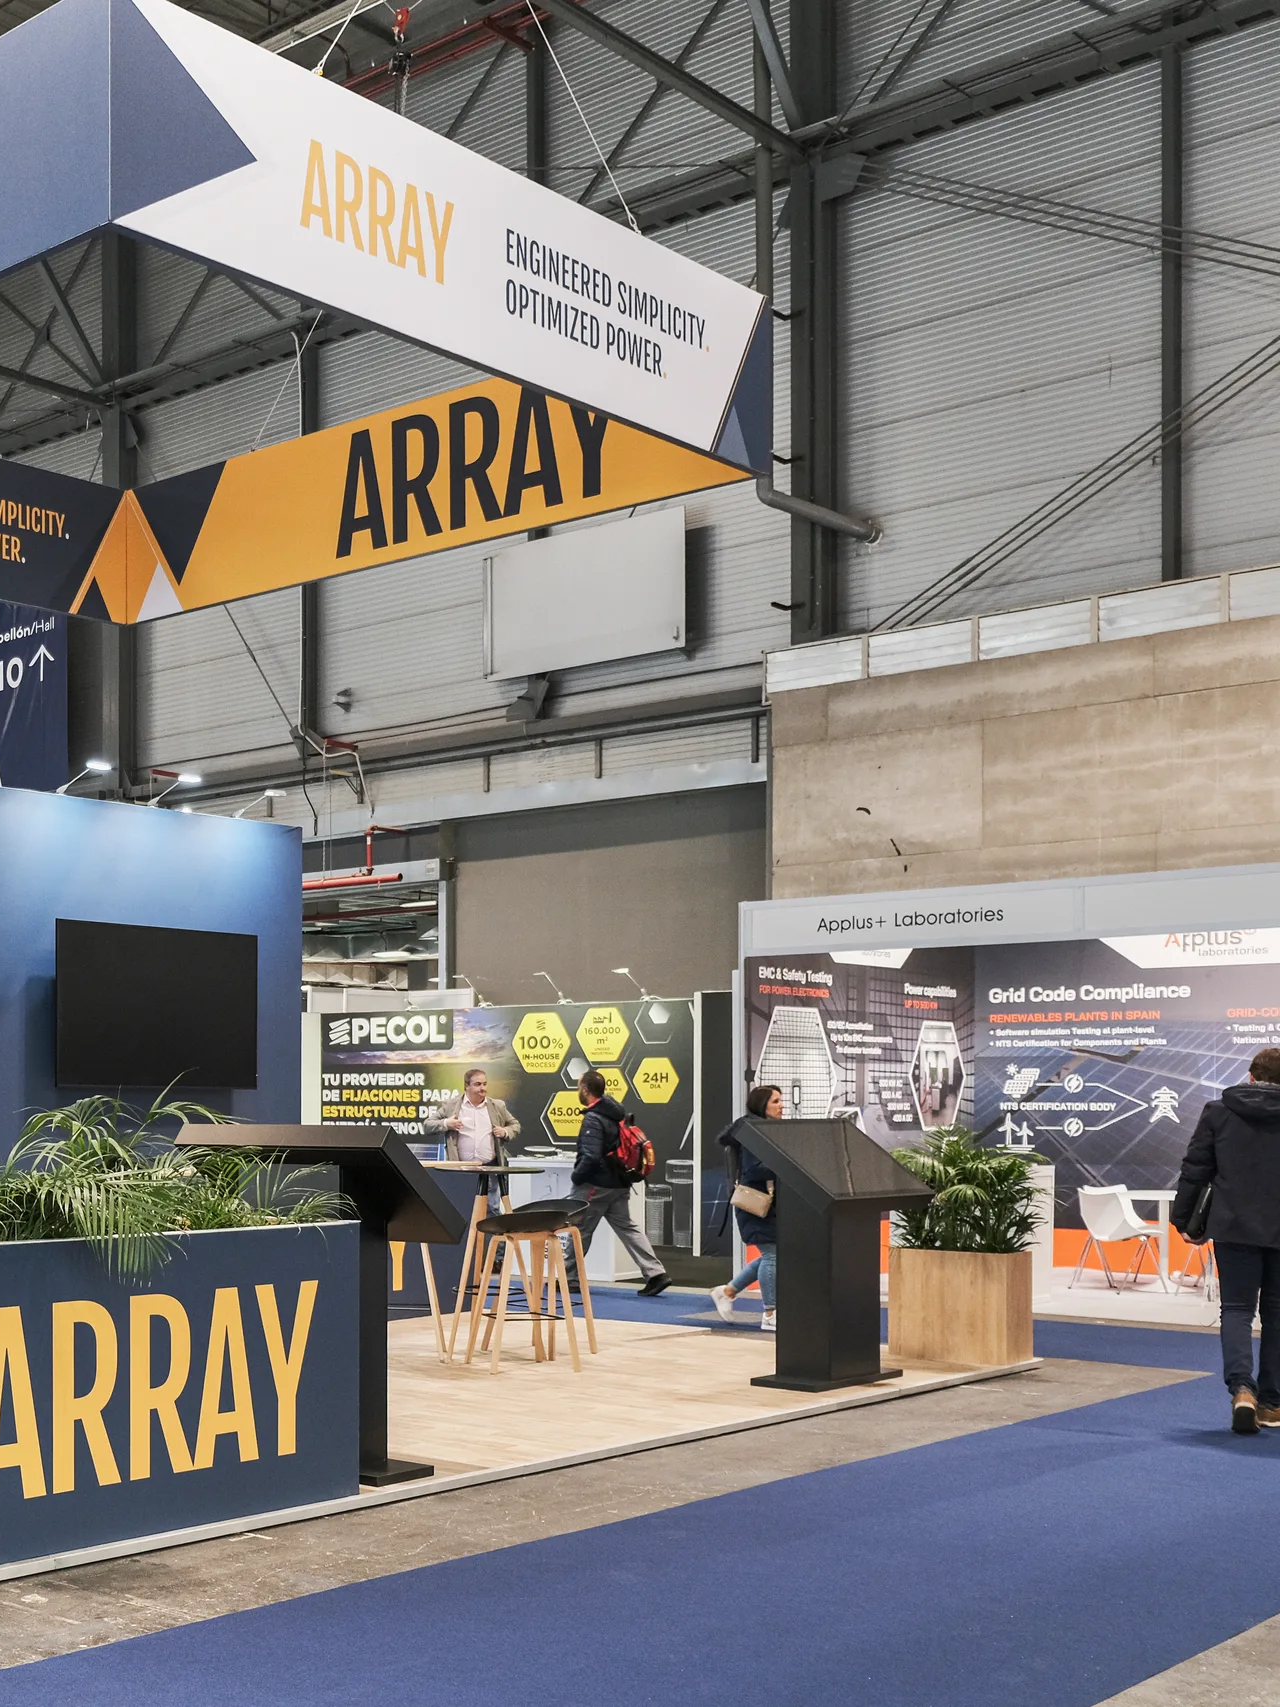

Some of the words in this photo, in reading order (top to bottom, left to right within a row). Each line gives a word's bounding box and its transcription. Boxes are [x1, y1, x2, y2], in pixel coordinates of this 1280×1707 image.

[299, 138, 455, 285] ARRAY
[506, 228, 612, 307] ENGINEERED
[617, 281, 710, 352] SIMPLICITY.
[506, 279, 600, 350] OPTIMIZED
[606, 322, 667, 379] POWER.
[335, 386, 609, 559] ARRAY
[817, 915, 887, 935] Applus+
[894, 907, 1004, 927] Laboratories
[1198, 946, 1269, 957] laboratories
[758, 966, 776, 980] EMC
[776, 967, 782, 980] &
[782, 968, 807, 985] Safety
[806, 970, 833, 987] Testing
[759, 984, 771, 994] FOR
[771, 985, 792, 996] POWER
[792, 987, 830, 999] ELECTRONICS
[904, 982, 923, 996] Power
[923, 985, 957, 999] capabilities
[988, 987, 1025, 1004] Grid
[1028, 985, 1076, 1003] Code
[1079, 982, 1191, 1004] Compliance
[989, 1012, 1063, 1024] RENEWABLES
[1064, 1011, 1109, 1022] PLANTS
[1111, 1011, 1123, 1021] IN
[1125, 1010, 1161, 1021] SPAIN
[1226, 1007, 1280, 1018] GRID-CO
[584, 1027, 621, 1035] 160.000
[995, 1027, 1030, 1036] Software
[1030, 1027, 1071, 1036] simulation
[1071, 1026, 1101, 1037] Testing
[1111, 1025, 1155, 1036] plant-level
[1233, 1024, 1266, 1033] Testing
[519, 1035, 564, 1050] 100%
[995, 1039, 1012, 1048] NTS
[1012, 1038, 1060, 1048] Certification
[1060, 1038, 1072, 1047] for
[1073, 1038, 1123, 1048] Components
[1124, 1037, 1139, 1046] and
[1140, 1037, 1168, 1046] Plants
[1233, 1036, 1271, 1044] National
[522, 1053, 560, 1061] IN-HOUSE
[322, 1073, 340, 1086] TU
[342, 1072, 425, 1086] PROVEEDOR
[642, 1072, 669, 1084] 24H
[322, 1089, 340, 1102] DE
[342, 1089, 420, 1103] FIJACIONES
[322, 1105, 417, 1118] ESTRUCTURAS
[418, 1106, 438, 1119] DE
[549, 1107, 581, 1117] 45.00
[1000, 1102, 1019, 1111] NTS
[1020, 1102, 1088, 1111] CERTIFICATION
[1089, 1102, 1117, 1111] BODY
